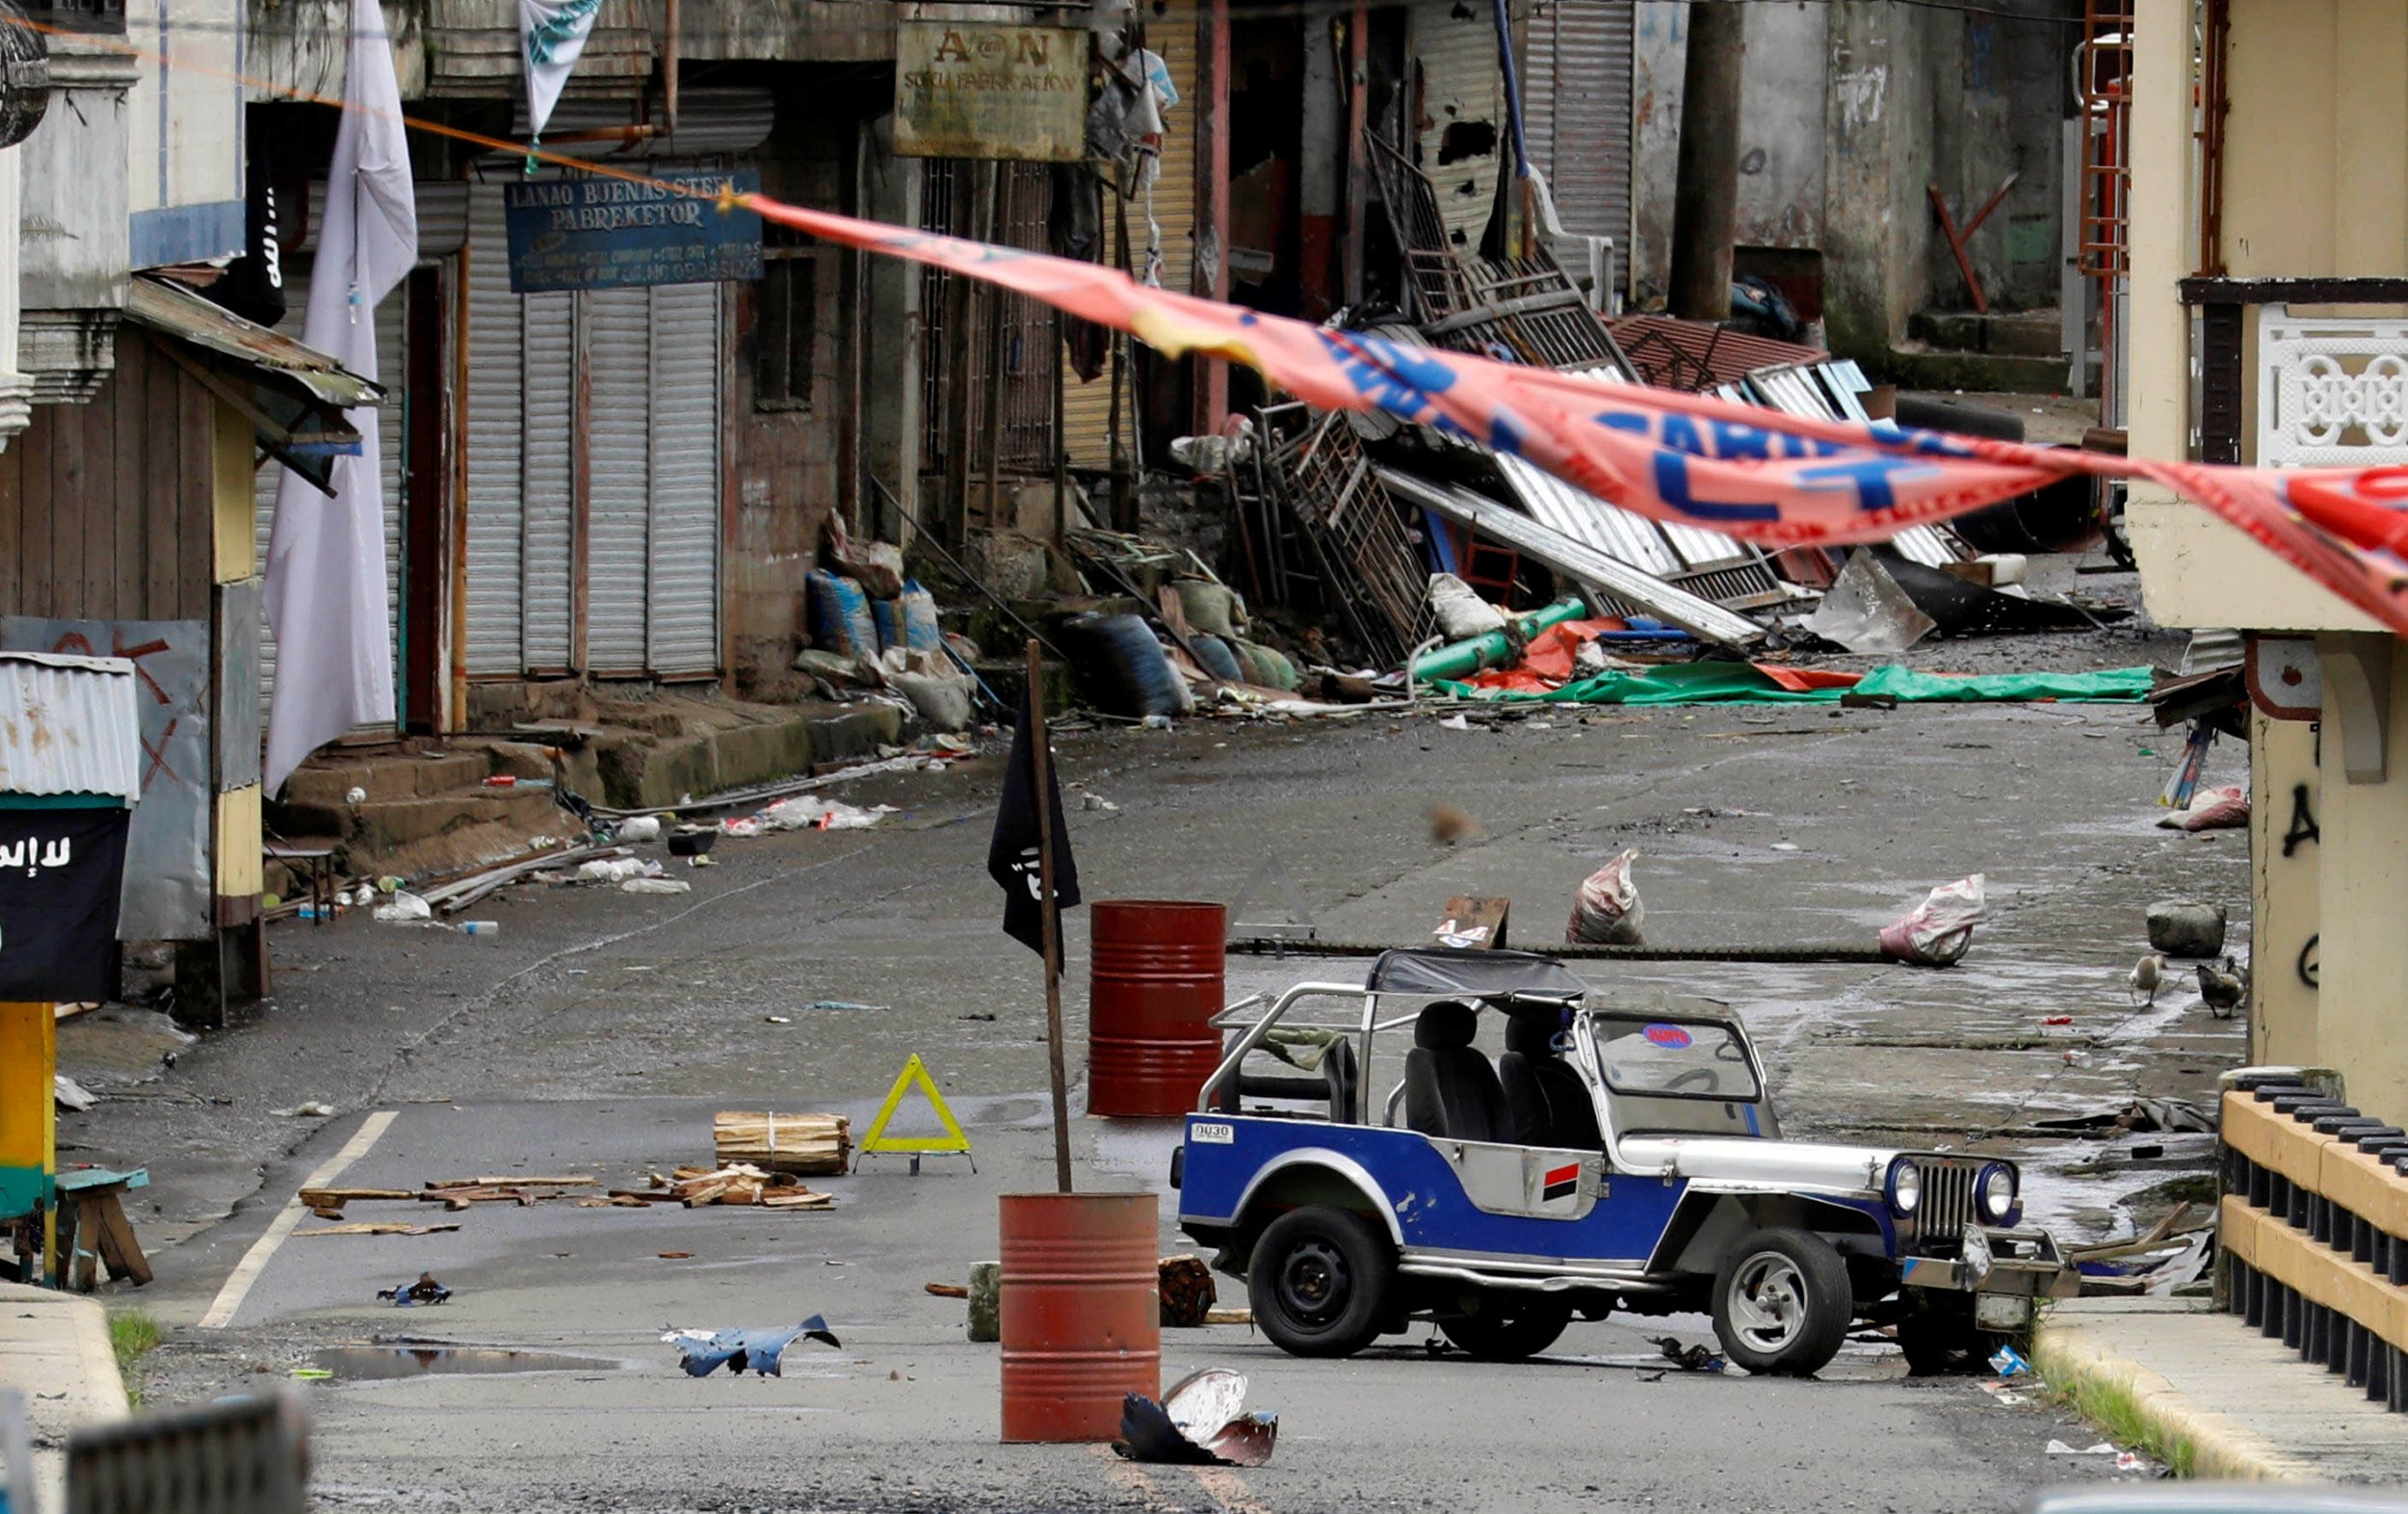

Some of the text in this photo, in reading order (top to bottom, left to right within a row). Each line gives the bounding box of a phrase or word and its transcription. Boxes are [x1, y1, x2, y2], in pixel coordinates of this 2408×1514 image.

[934, 28, 970, 63] A
[1017, 34, 1050, 66] N
[511, 185, 575, 208] LANAO
[551, 201, 704, 231] PABREKETOR
